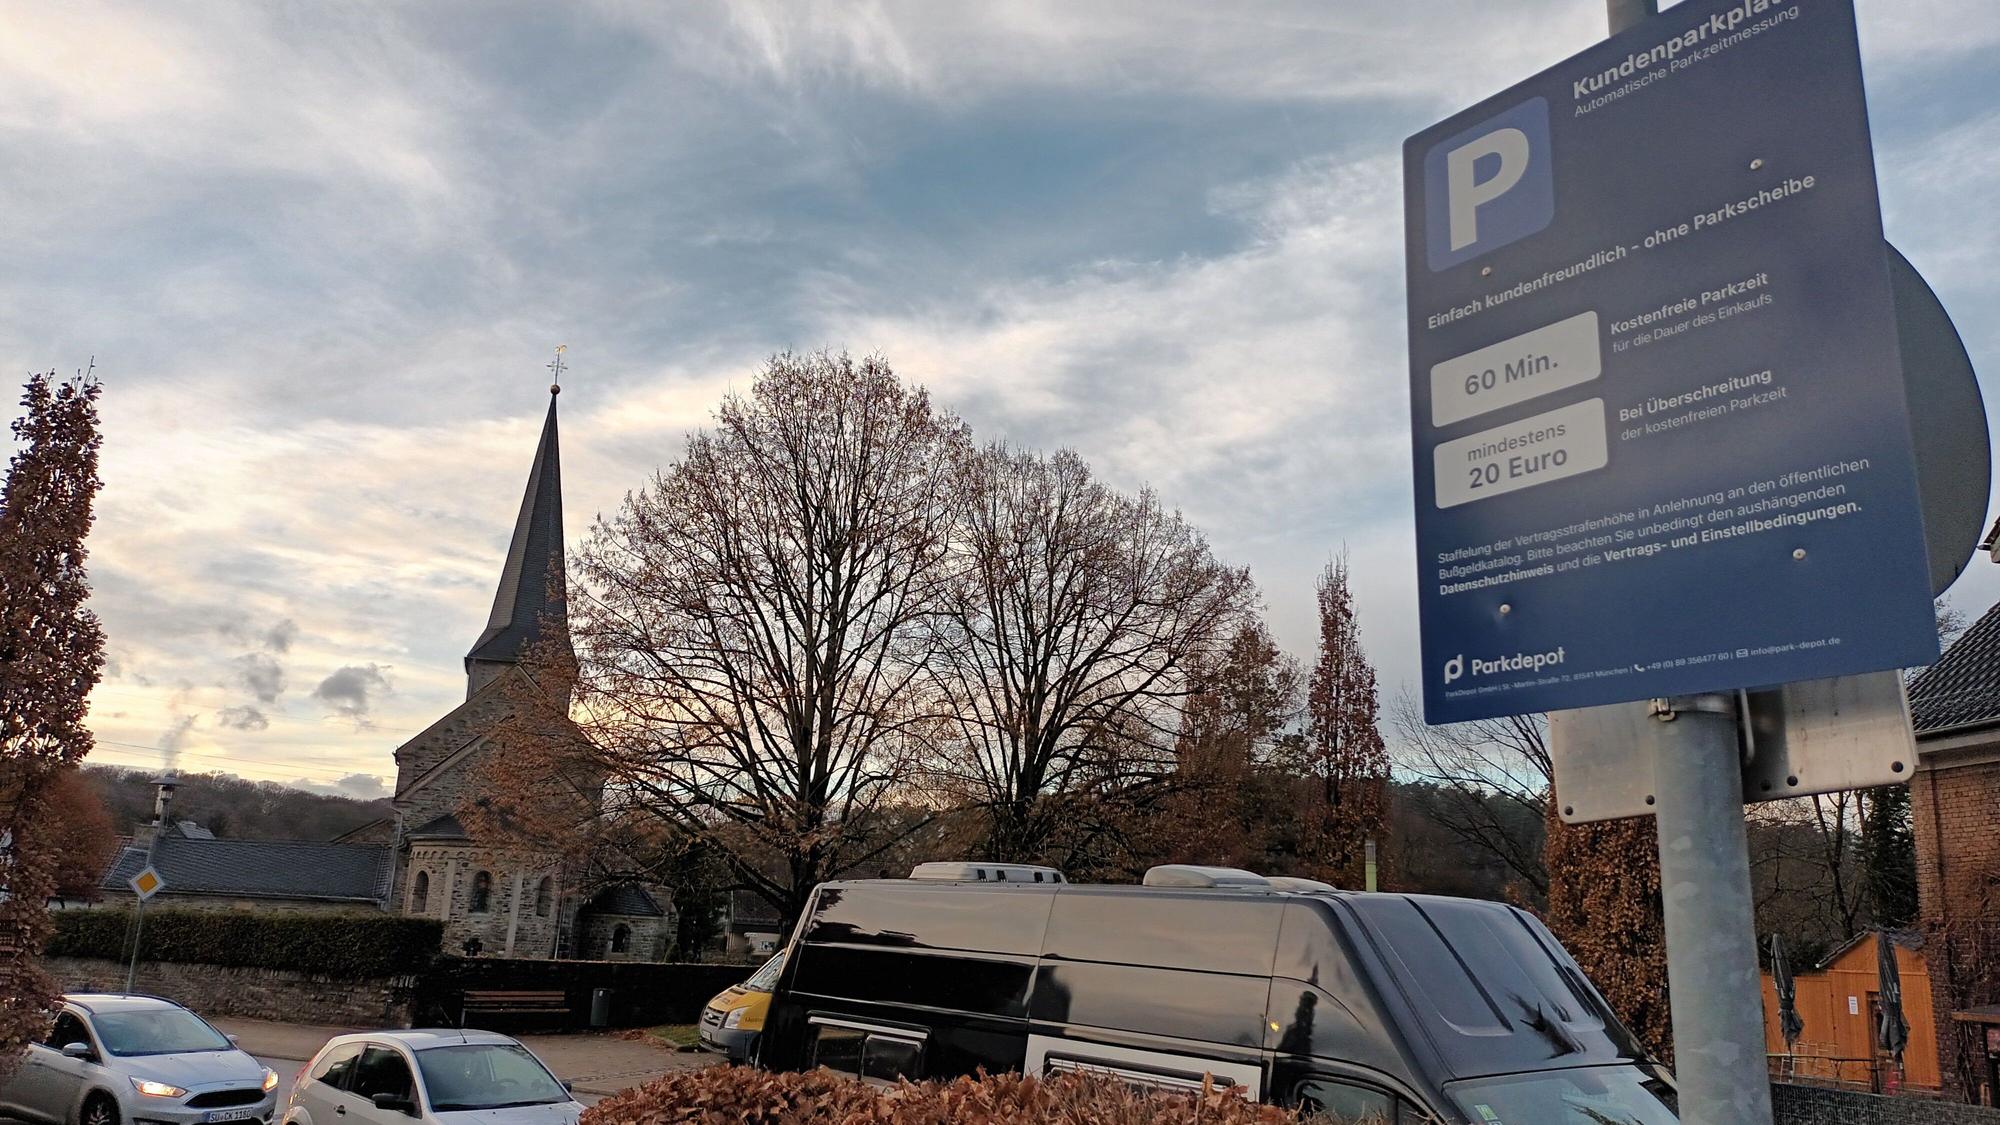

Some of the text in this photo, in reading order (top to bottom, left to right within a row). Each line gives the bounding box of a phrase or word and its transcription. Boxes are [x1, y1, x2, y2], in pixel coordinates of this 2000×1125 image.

[1573, 0, 1782, 99] Kundenparkpla
[1574, 5, 1799, 117] Automatische Parkzeitmessung
[1447, 127, 1530, 252] P
[1428, 300, 1482, 329] Einfach
[1485, 245, 1626, 308] kundenfreundlich
[1644, 223, 1689, 248] ohne
[1693, 175, 1815, 230] Parkscheibe
[1610, 272, 1768, 335] Kostenfreie Parkzeit
[1613, 293, 1773, 353] für die Dauer des Einkaufs
[1464, 354, 1558, 395] 60 Min.
[1619, 370, 1772, 422] Bei Überschreitung
[1467, 424, 1566, 462] mindestens
[1621, 386, 1787, 441] der kostenfreien Parkzeit
[1469, 449, 1567, 489] 20 Euro
[1438, 458, 1870, 564] Staffelung der Vertragsstrafenhöhe in Anlehnung an den öffentlichen
[1439, 483, 1846, 580] Bußgeldkatalog. Bitte beachten Sie unbedingt den aushängenden
[1439, 501, 1862, 596] Datenschutzhinweis und die Vertrags- und Einstellbedingungen.
[1472, 646, 1566, 676] Parkdepot
[1595, 667, 1629, 678] München
[1646, 662, 1661, 671] +49
[1662, 659, 1674, 668] (0)
[1675, 658, 1686, 666] 89
[1718, 652, 1729, 661] 60
[1750, 637, 1841, 656] info@park-depot.de
